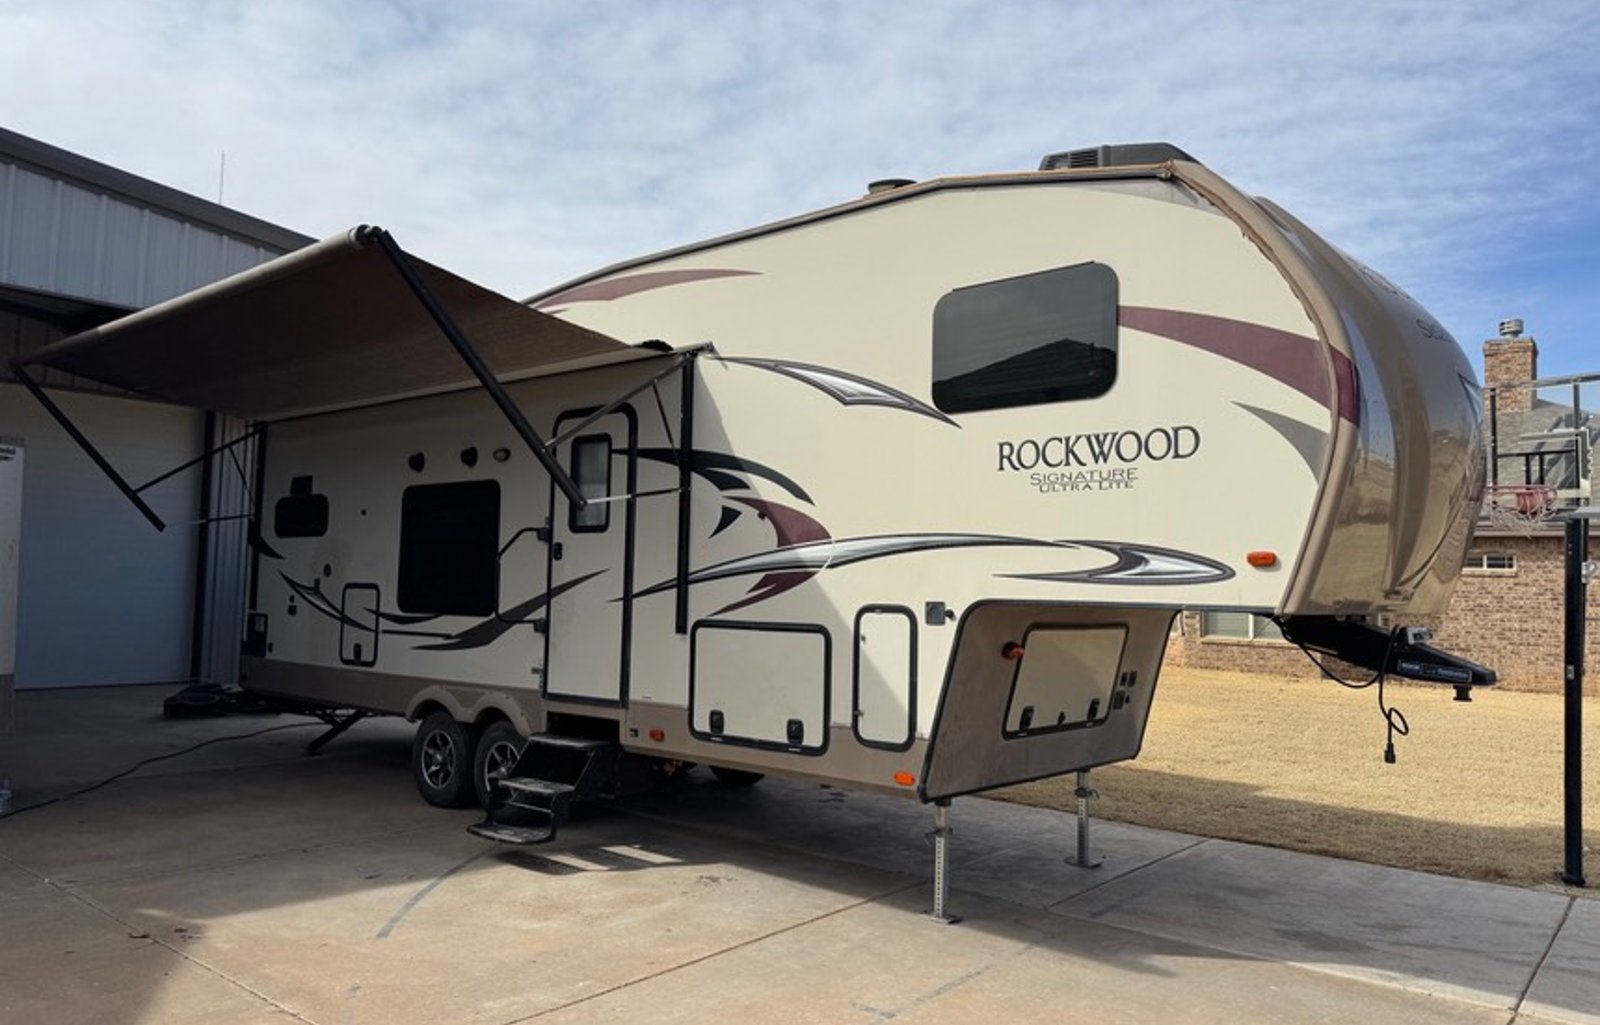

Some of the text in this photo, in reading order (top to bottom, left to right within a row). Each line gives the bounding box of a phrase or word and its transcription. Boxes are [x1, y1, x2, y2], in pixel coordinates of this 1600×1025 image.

[997, 426, 1200, 472] ROCKWOOD
[1030, 468, 1138, 486] SIGNATURE
[1039, 480, 1134, 493] ULTRA LITE
